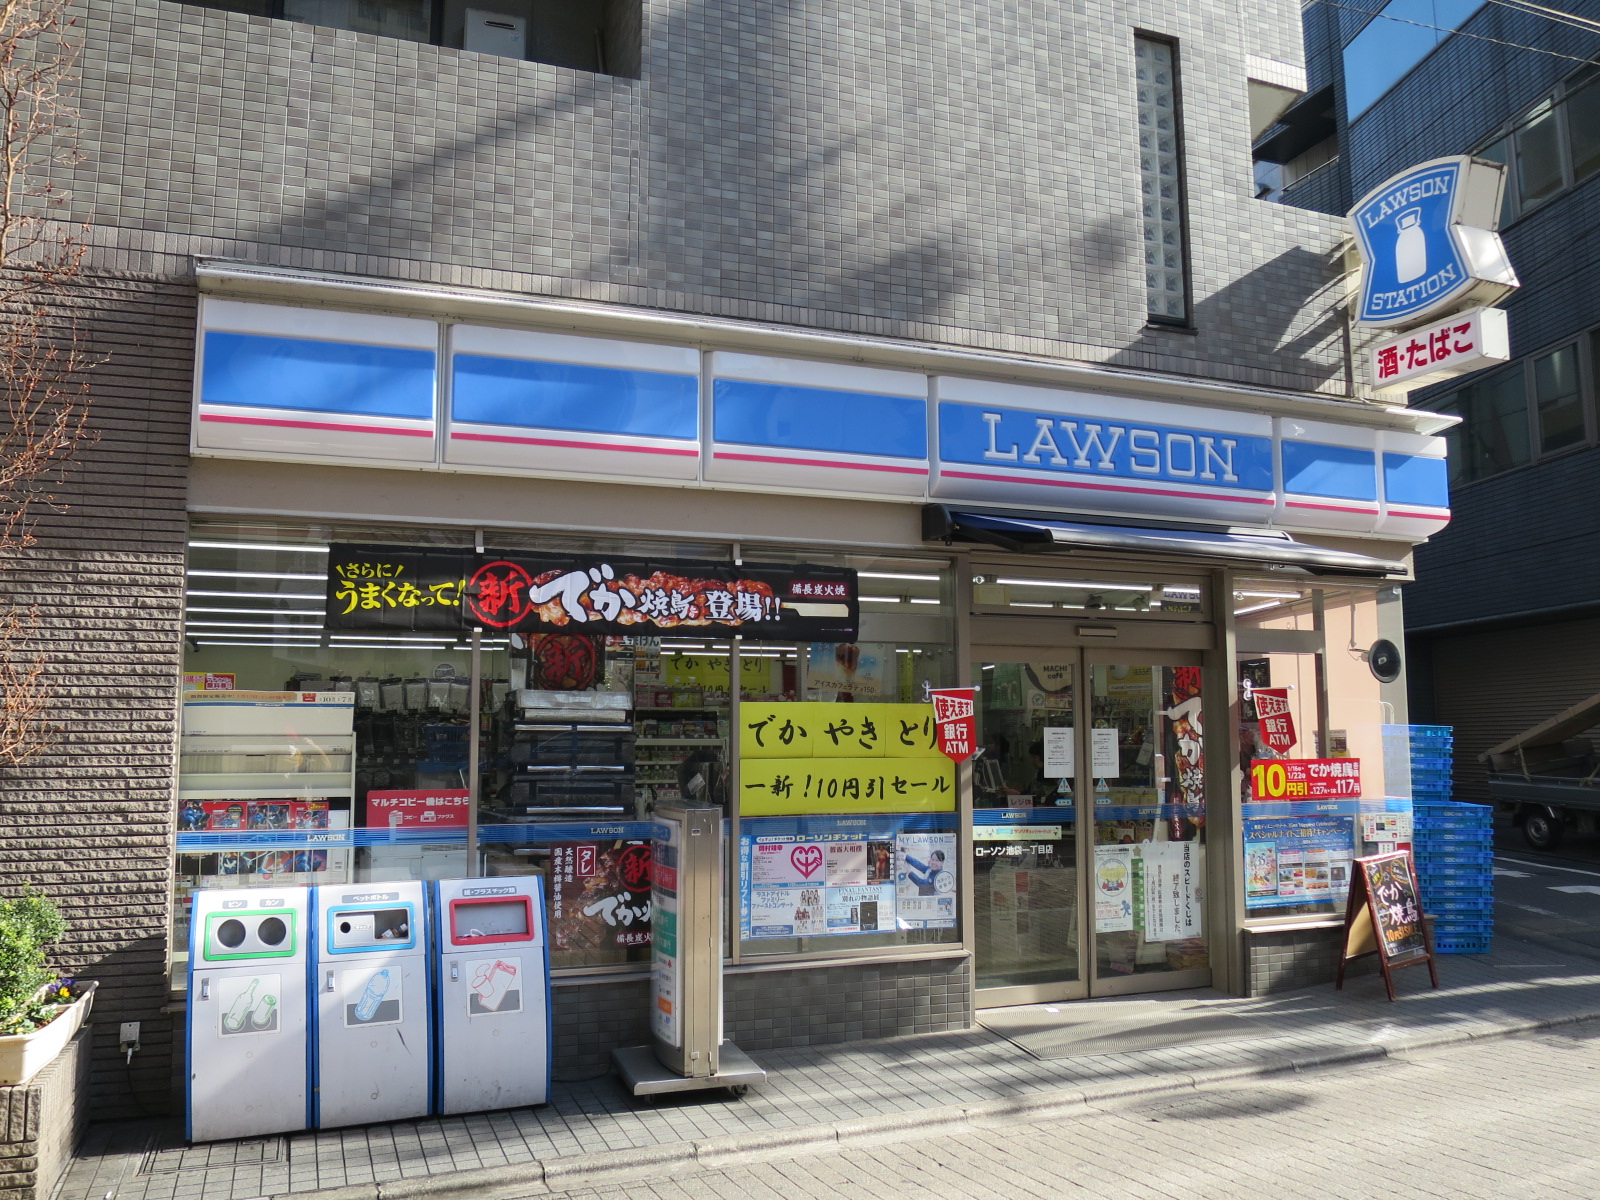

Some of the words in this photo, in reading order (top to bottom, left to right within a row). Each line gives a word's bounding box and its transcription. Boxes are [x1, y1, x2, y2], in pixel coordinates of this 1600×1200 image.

[1365, 175, 1450, 229] LAWSON
[1371, 263, 1457, 311] STATION
[1377, 321, 1474, 379] 酒・たばこ
[982, 412, 1239, 483] LAWSON
[345, 562, 393, 579] さらに
[477, 571, 521, 616] 新
[792, 583, 846, 596] 備長炭火焼
[1047, 672, 1064, 680] café
[943, 723, 968, 740] 銀行
[1265, 718, 1288, 733] 銀行
[945, 740, 969, 754] ATM
[1269, 734, 1291, 746] ATM
[371, 796, 469, 807] マルチコピー機はこちら
[307, 834, 346, 842] LAWSON
[796, 833, 867, 842] ローソンチケット
[912, 836, 944, 844] LAWSON
[975, 844, 1054, 857] ローソン池袋一丁目店
[580, 849, 592, 874] タレ
[1376, 881, 1403, 906] でか
[1388, 897, 1418, 926] 焼鳥
